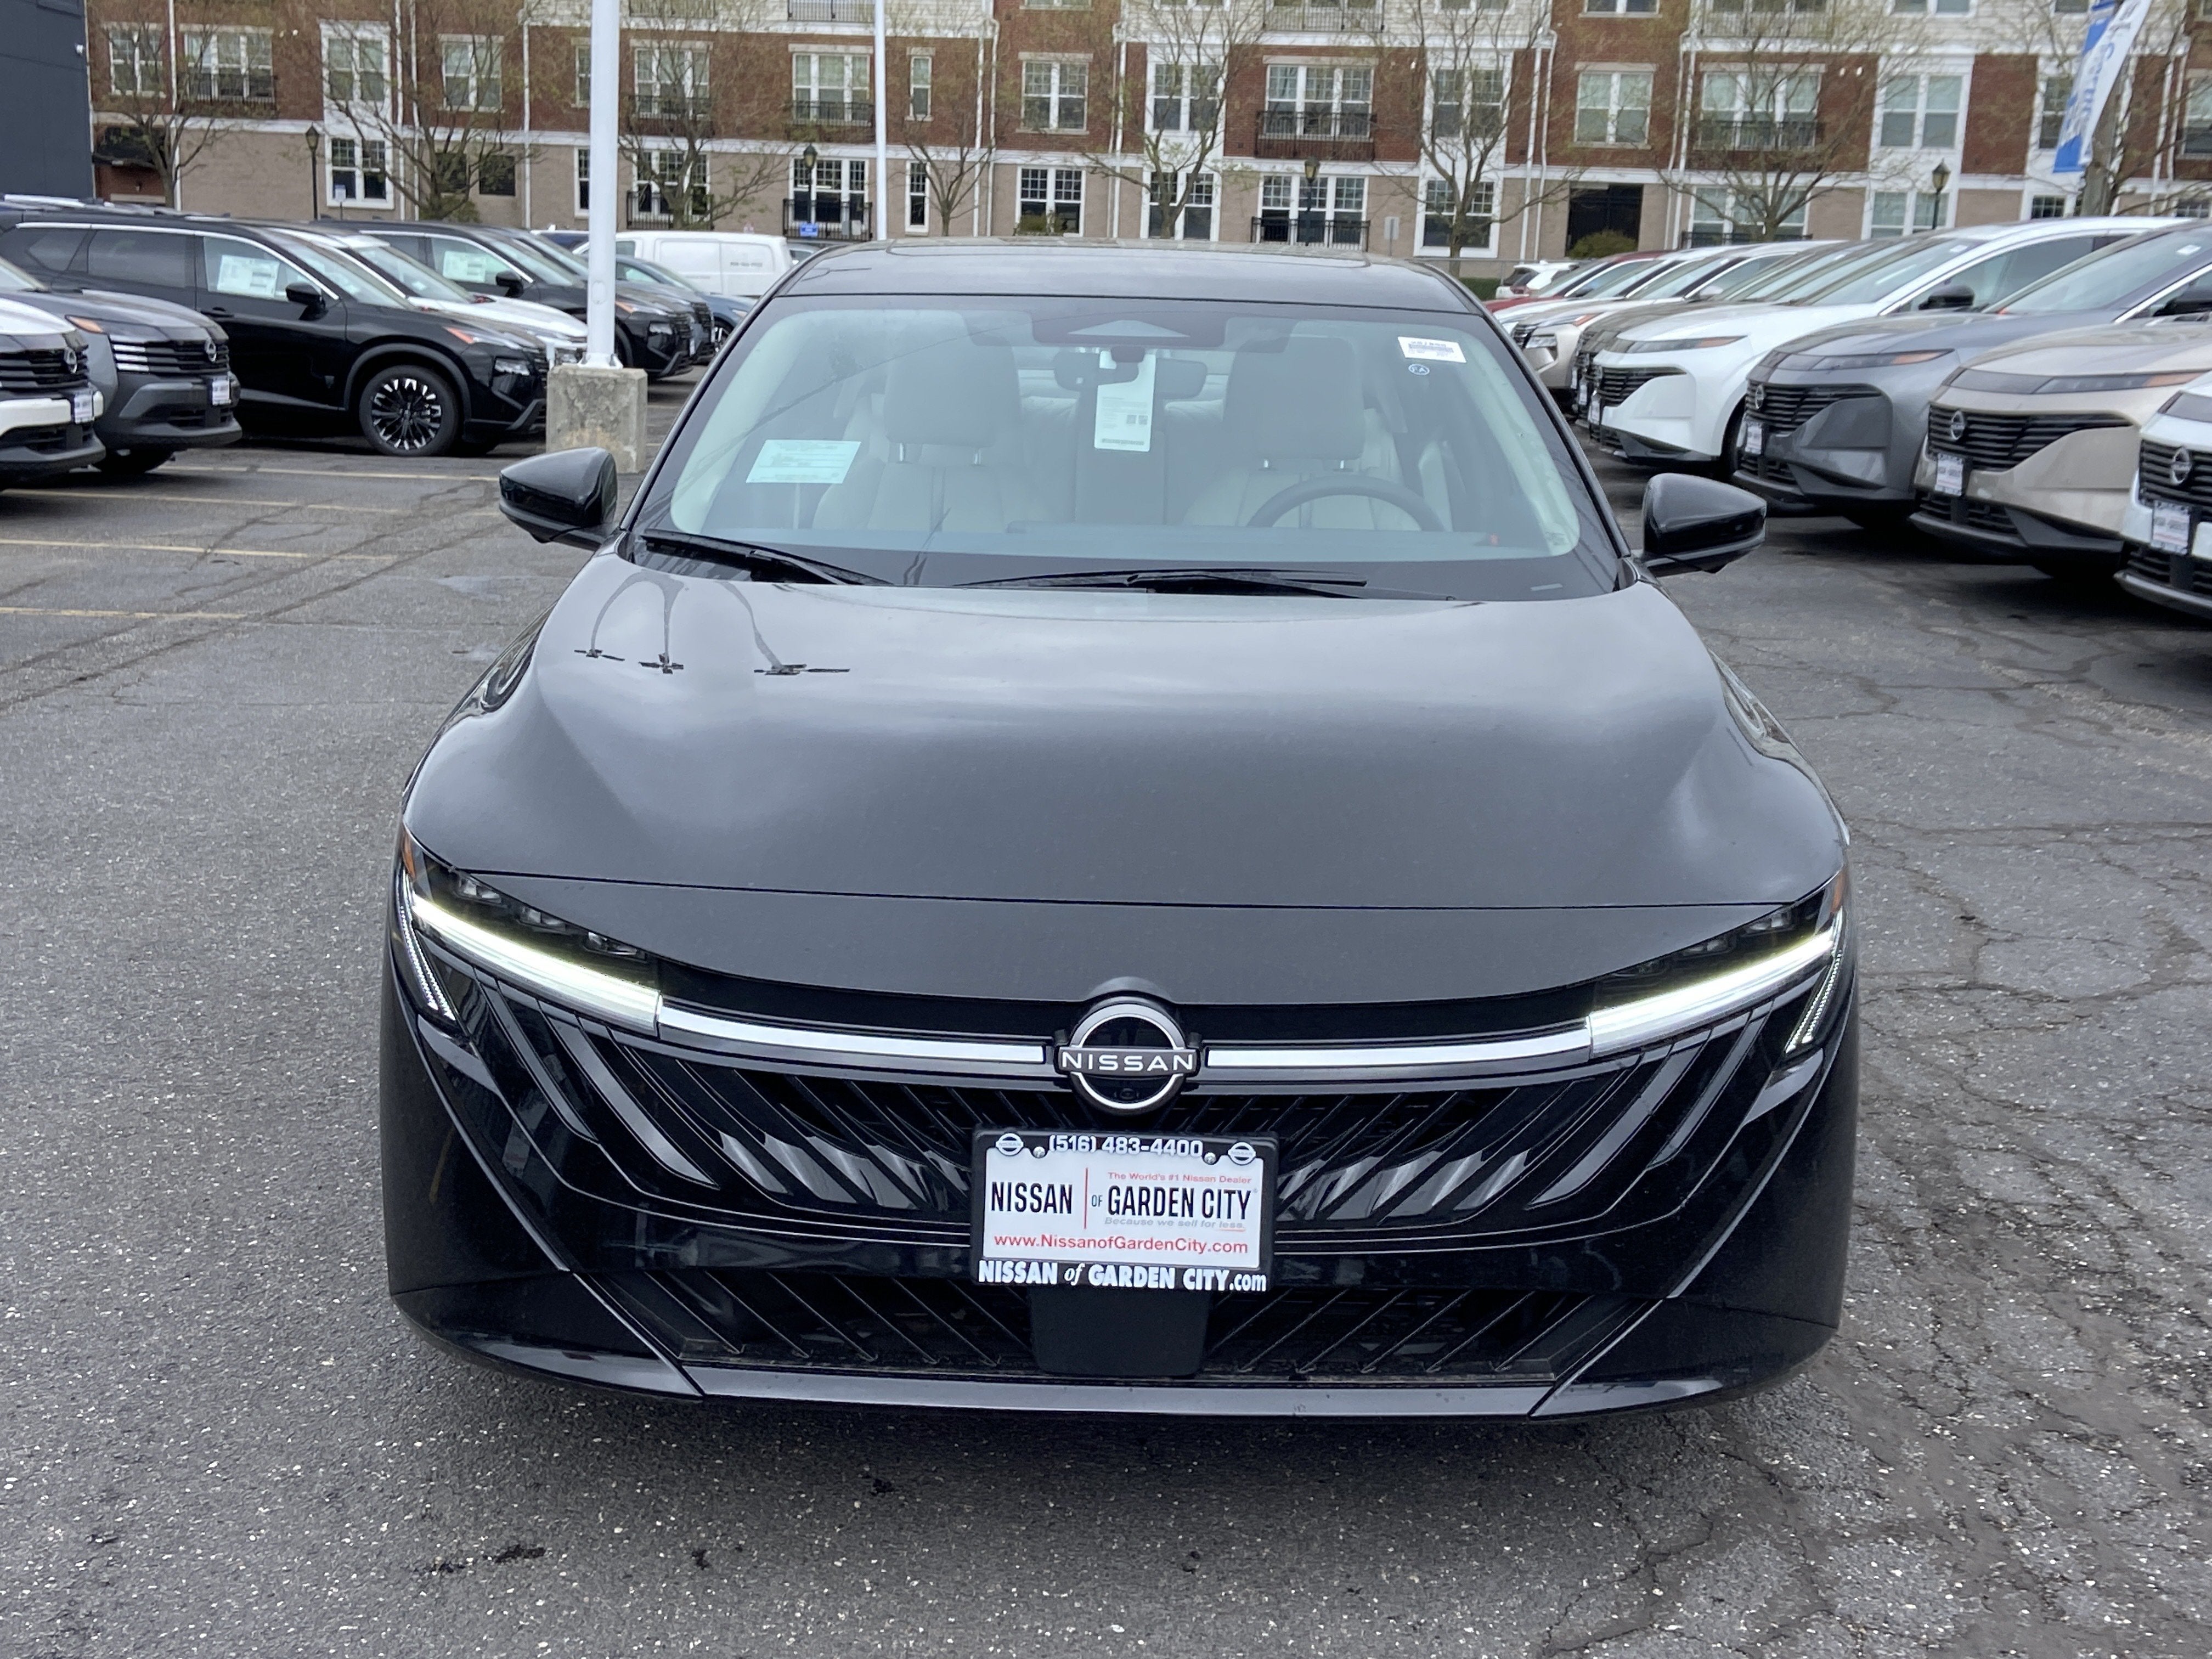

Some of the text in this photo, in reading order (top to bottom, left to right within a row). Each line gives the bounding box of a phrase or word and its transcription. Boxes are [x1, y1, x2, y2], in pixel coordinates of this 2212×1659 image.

[1062, 1052, 1193, 1071] NISSAN
[1049, 1135, 1204, 1157] (516) 483-4400
[1129, 1172, 1166, 1181] World's
[1182, 1175, 1216, 1183] Nissan
[1219, 1175, 1252, 1183] Dealer
[991, 1182, 1251, 1220] NISSAN OF GARDEN CITY
[1104, 1216, 1154, 1226] Because
[1178, 1218, 1197, 1228] sell
[1200, 1219, 1216, 1228] for
[994, 1234, 1248, 1254] www.NissanofGardenCity.com
[979, 1260, 1267, 1291] NISSAN of GARDEN CITY.com
